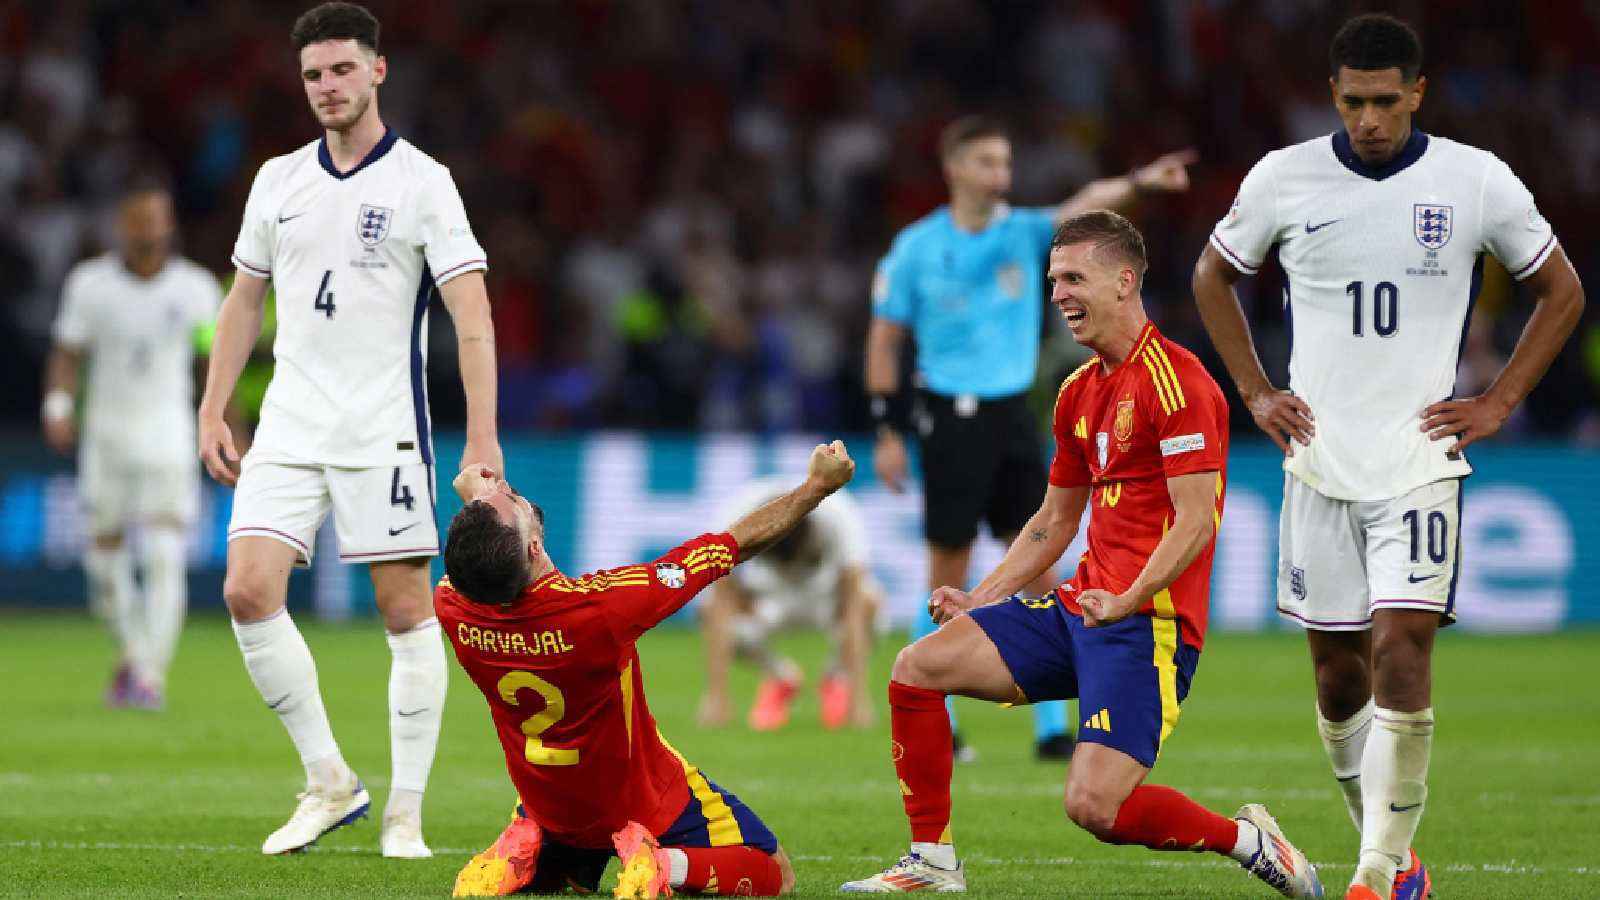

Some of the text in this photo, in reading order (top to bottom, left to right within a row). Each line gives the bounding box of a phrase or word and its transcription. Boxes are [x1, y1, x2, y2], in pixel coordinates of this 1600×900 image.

[315, 269, 336, 318] 4
[1346, 281, 1400, 337] 10
[391, 466, 414, 511] 4
[1403, 509, 1448, 564] 10
[457, 622, 574, 655] CARVAJAL
[497, 671, 580, 766] 2
